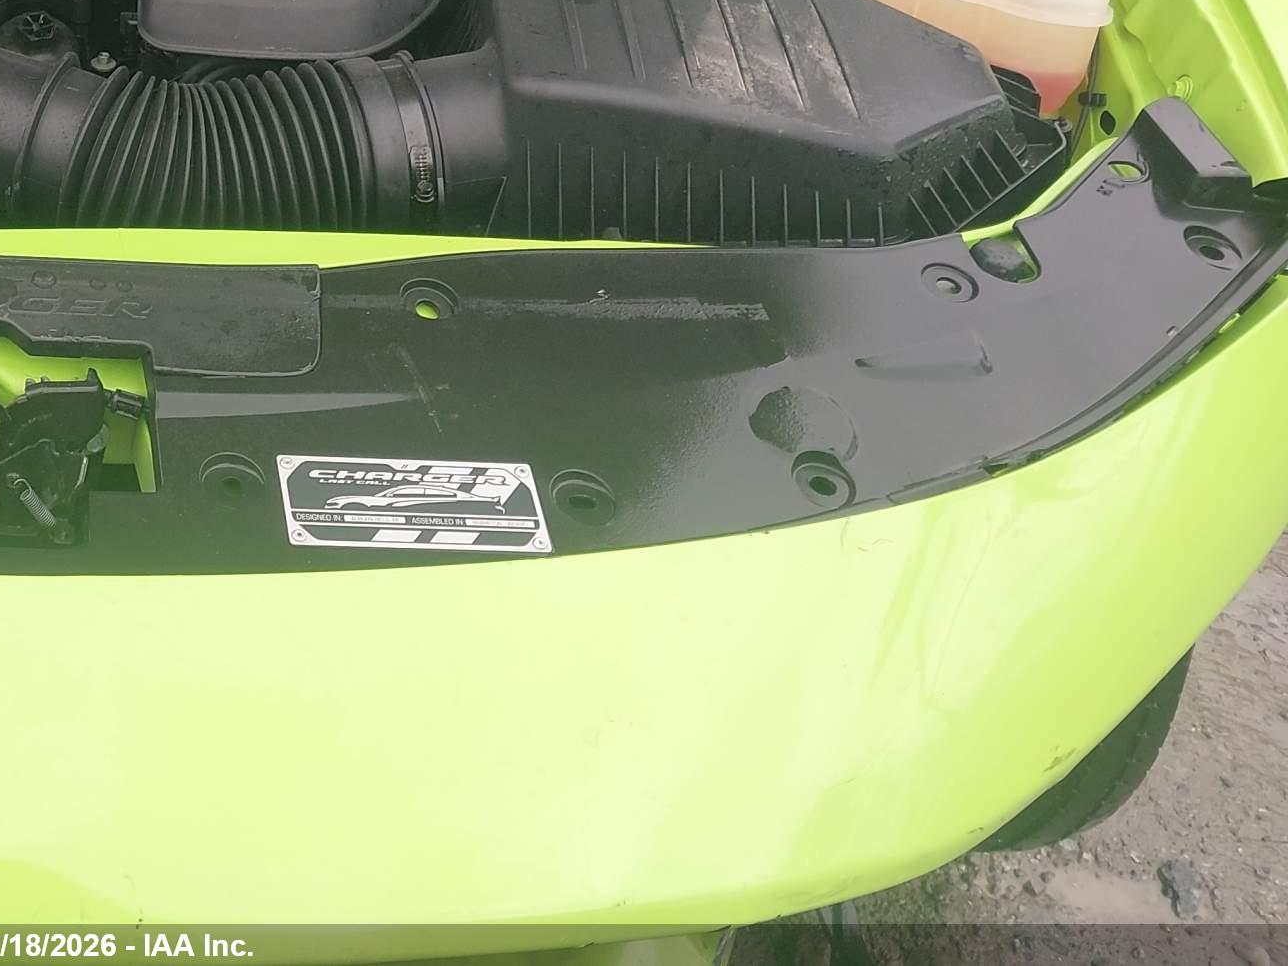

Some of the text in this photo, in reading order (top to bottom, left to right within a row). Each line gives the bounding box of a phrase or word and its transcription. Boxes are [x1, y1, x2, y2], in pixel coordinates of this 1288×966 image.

[308, 469, 510, 487] CHARGER
[295, 513, 332, 522] DESIGNED
[411, 516, 454, 526] ASSEMBLED
